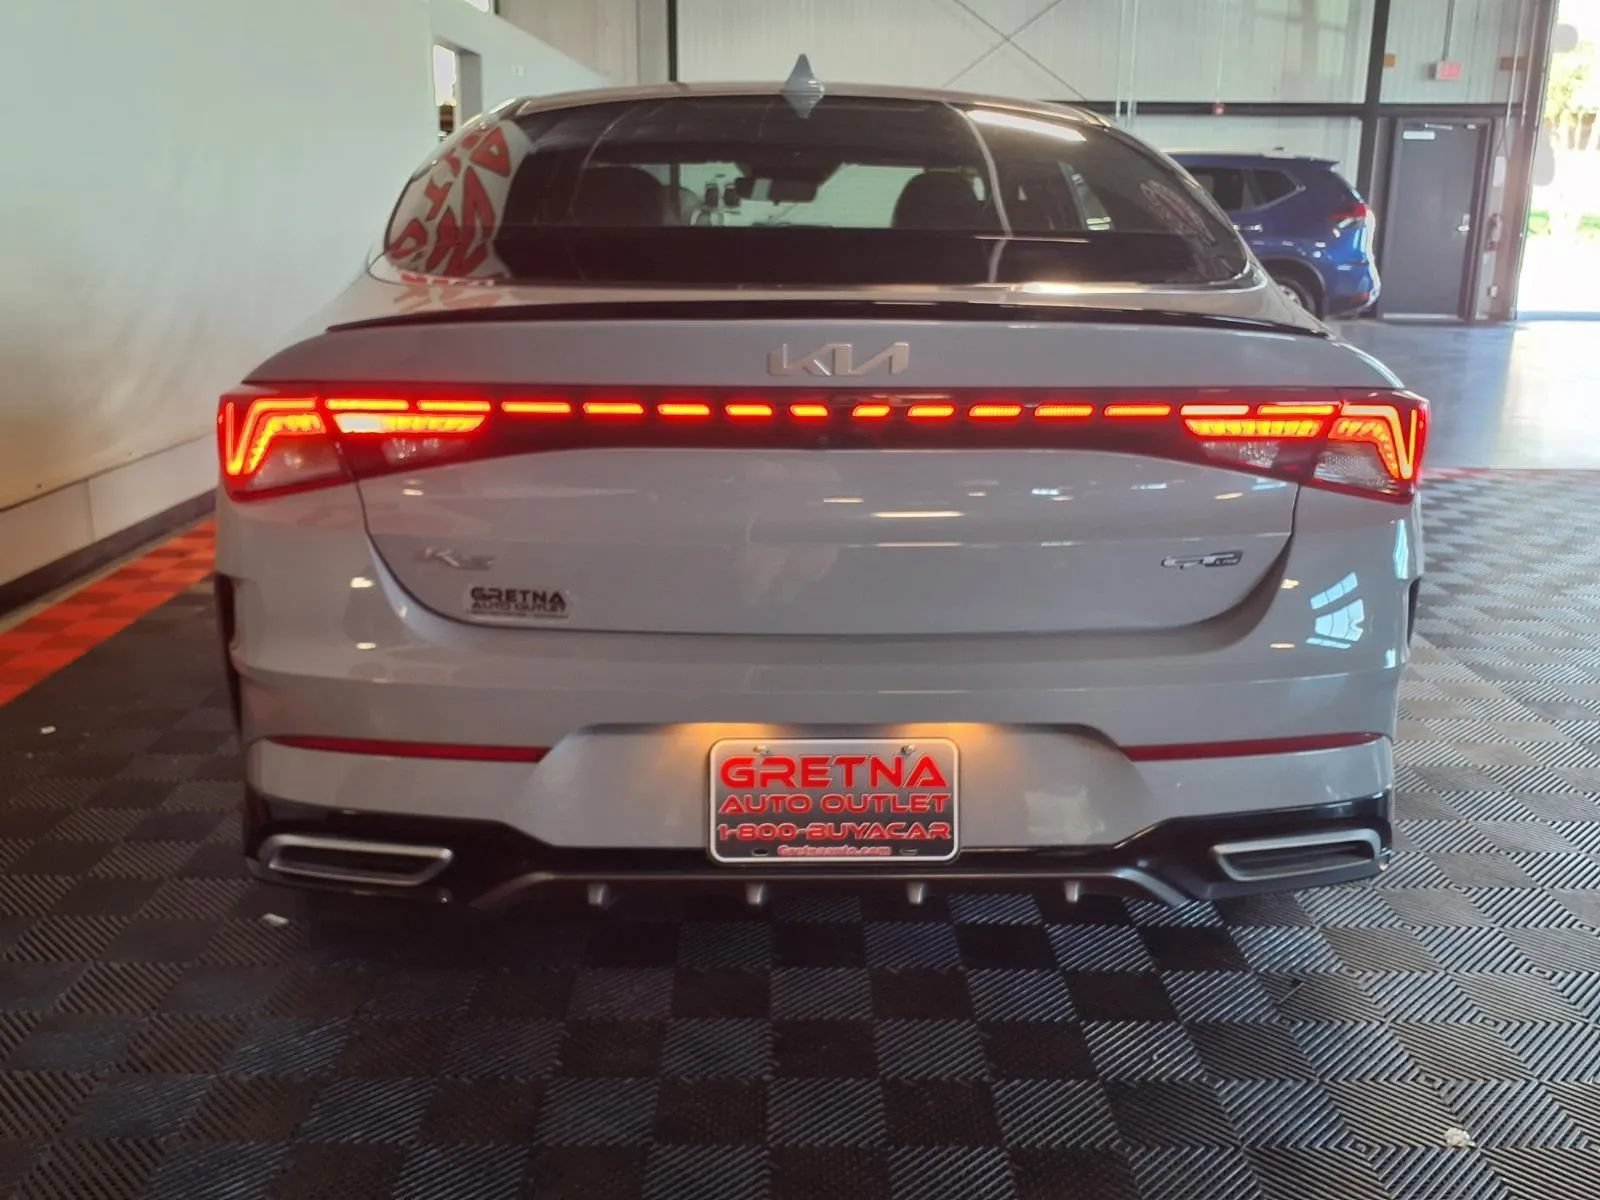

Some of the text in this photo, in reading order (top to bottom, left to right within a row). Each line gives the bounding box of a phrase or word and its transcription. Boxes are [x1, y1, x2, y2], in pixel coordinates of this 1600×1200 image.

[471, 586, 565, 605] GRETNA
[471, 601, 511, 611] AUTO
[720, 755, 950, 789] GRETNA
[718, 793, 951, 815] AUTO OUTLET
[717, 822, 952, 842] 1-800-BUYACAR
